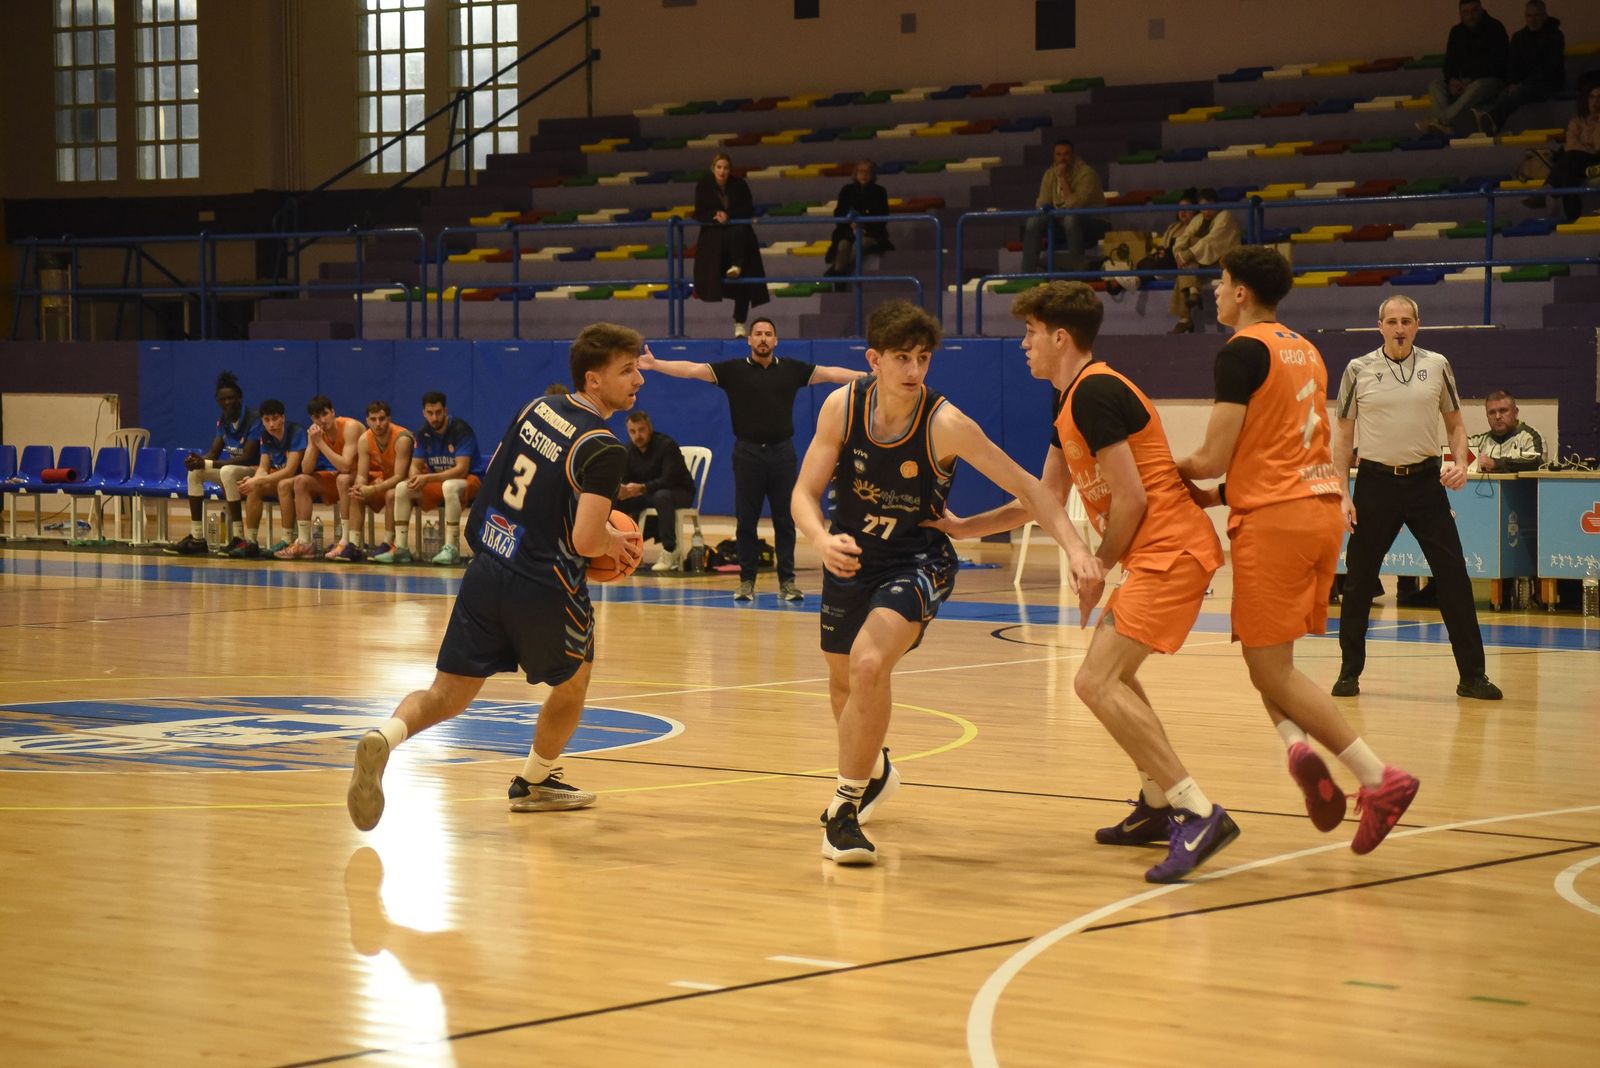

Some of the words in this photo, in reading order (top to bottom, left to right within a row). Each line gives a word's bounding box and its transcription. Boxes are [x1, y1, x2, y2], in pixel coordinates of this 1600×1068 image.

[502, 453, 538, 512] 3
[481, 523, 516, 559] UBAGO
[861, 512, 898, 541] 27
